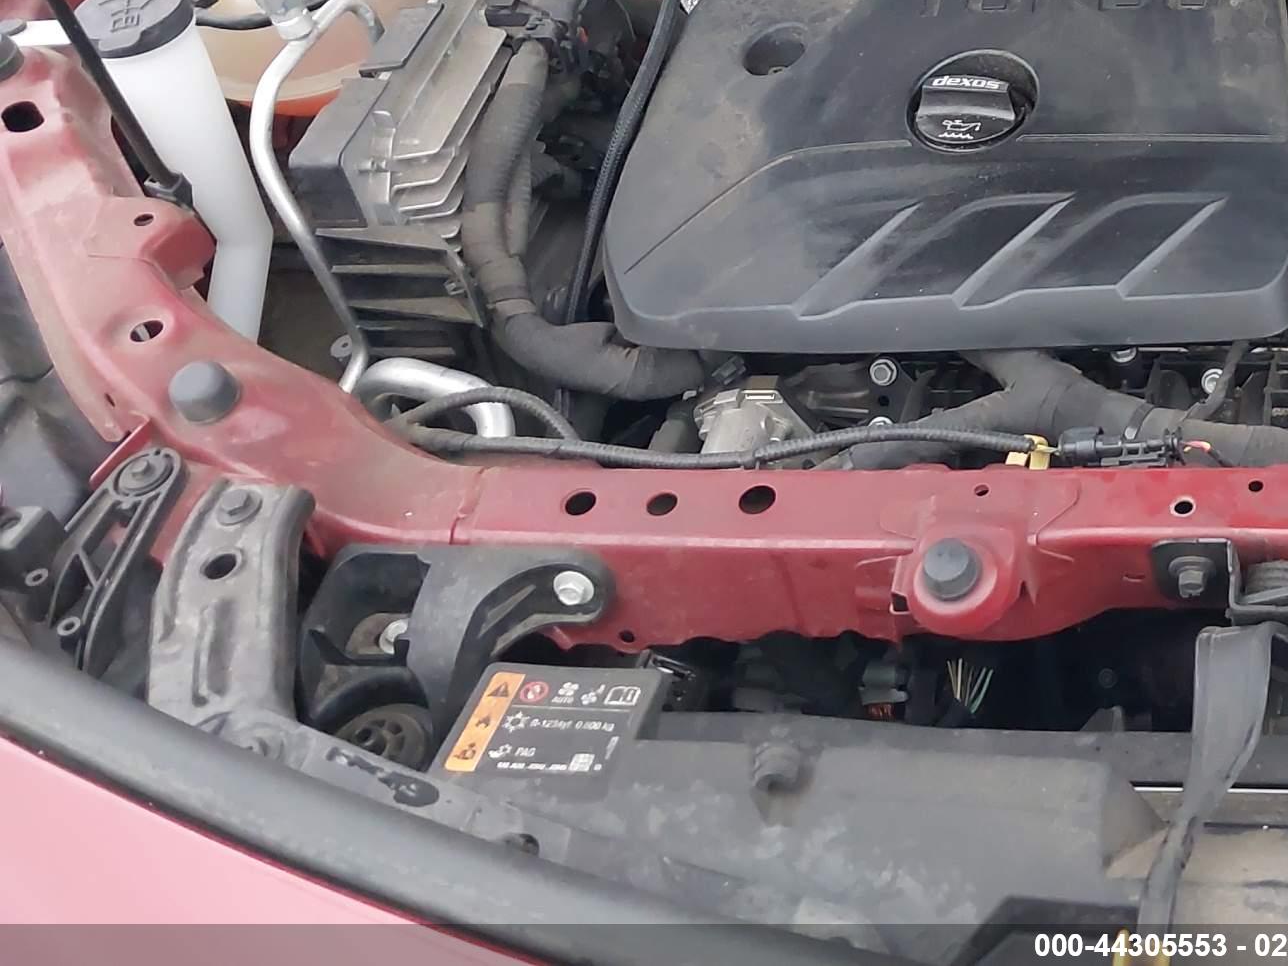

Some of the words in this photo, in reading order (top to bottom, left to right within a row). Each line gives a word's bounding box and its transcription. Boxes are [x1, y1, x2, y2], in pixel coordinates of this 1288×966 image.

[931, 75, 1000, 90] dexos
[552, 696, 574, 704] AUTO
[515, 747, 536, 757] PAG
